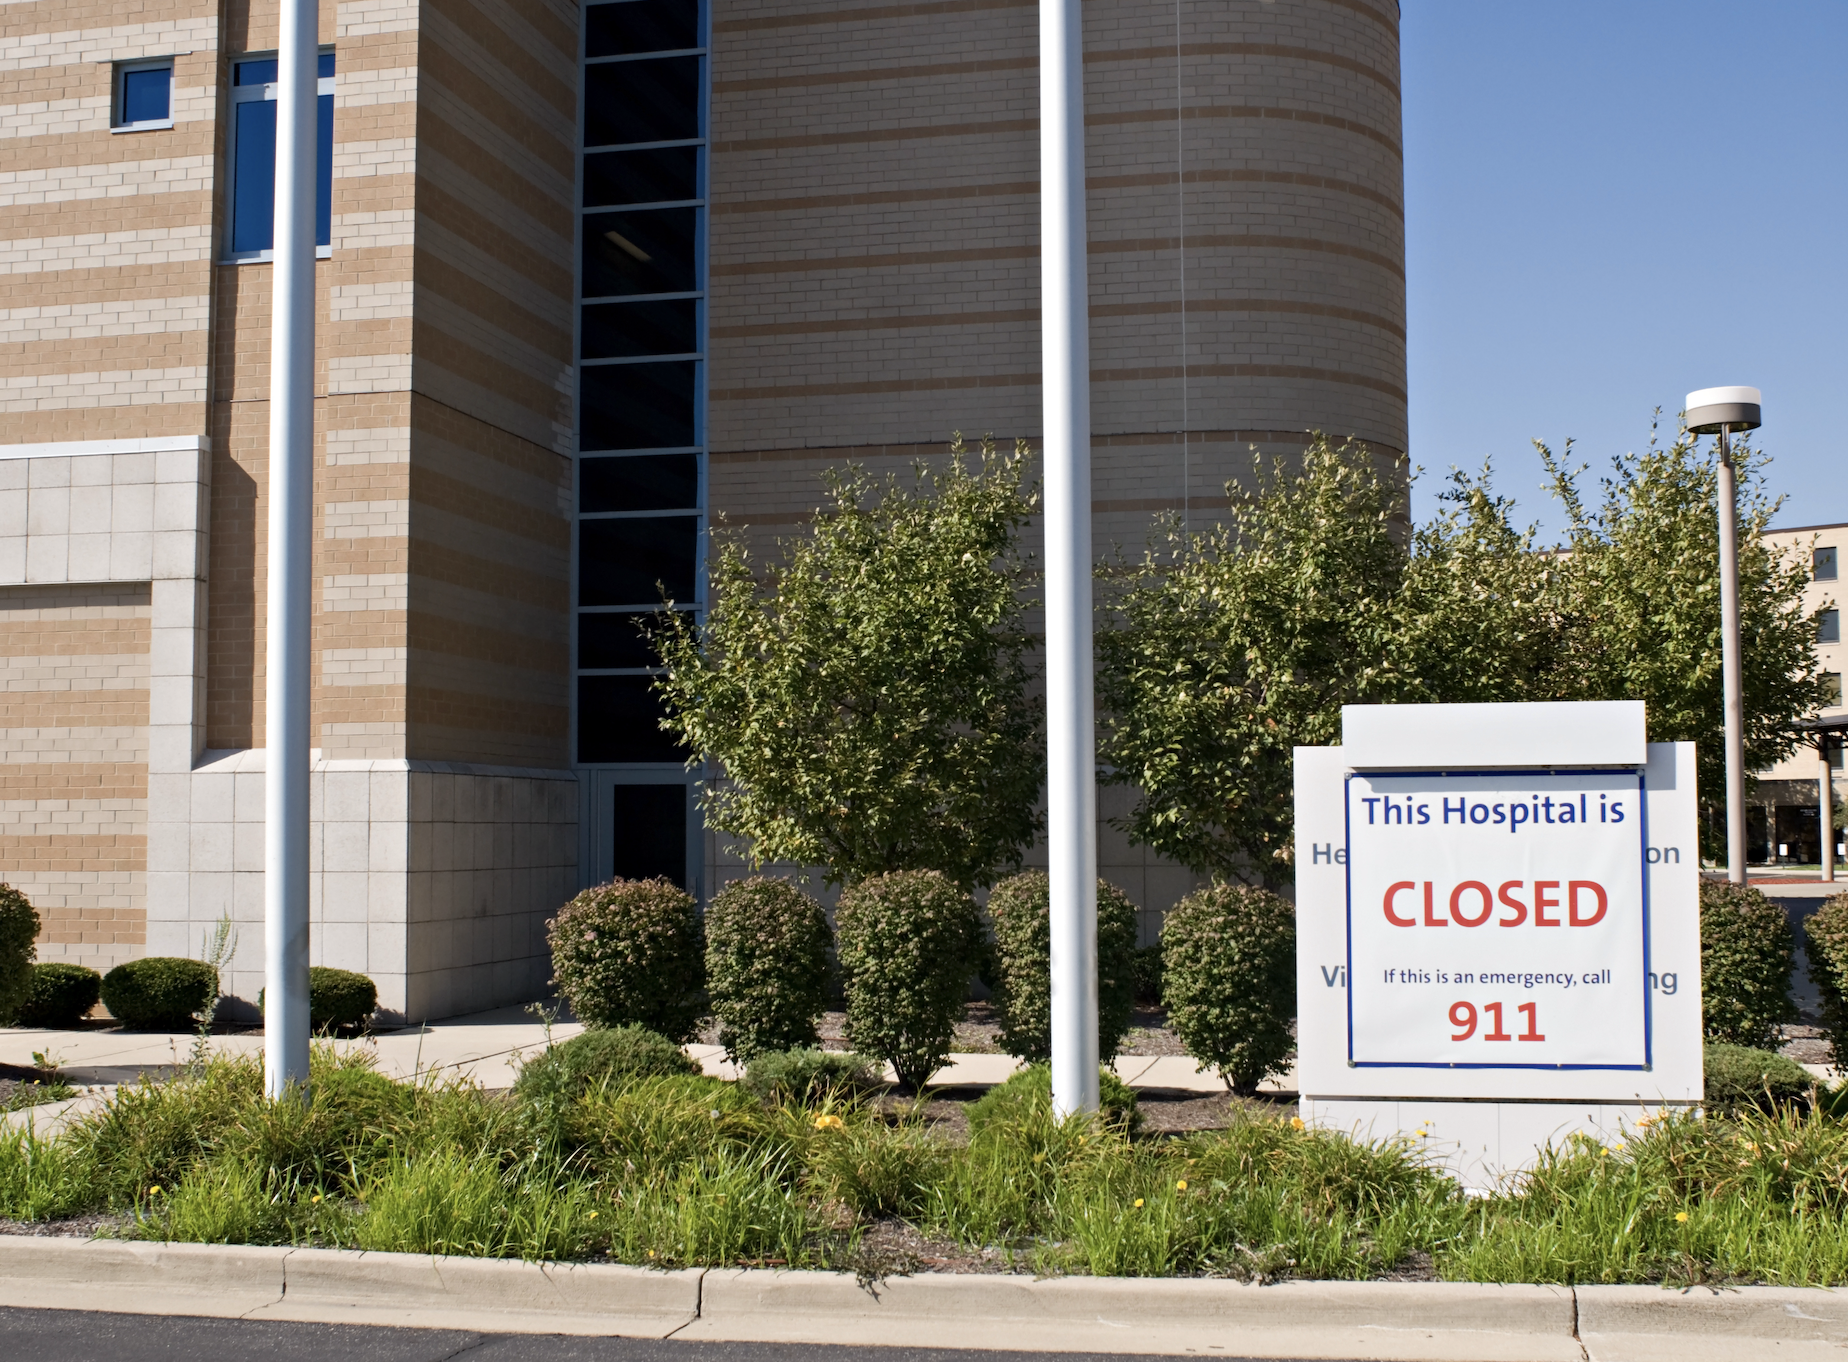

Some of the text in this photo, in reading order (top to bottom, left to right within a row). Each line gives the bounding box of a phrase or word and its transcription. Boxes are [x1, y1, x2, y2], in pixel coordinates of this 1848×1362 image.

[1362, 793, 1625, 834] This Hospital is
[1382, 880, 1608, 928] CLOSED
[1384, 968, 1611, 987] If this is an emergency, call
[1448, 1001, 1546, 1042] 911
